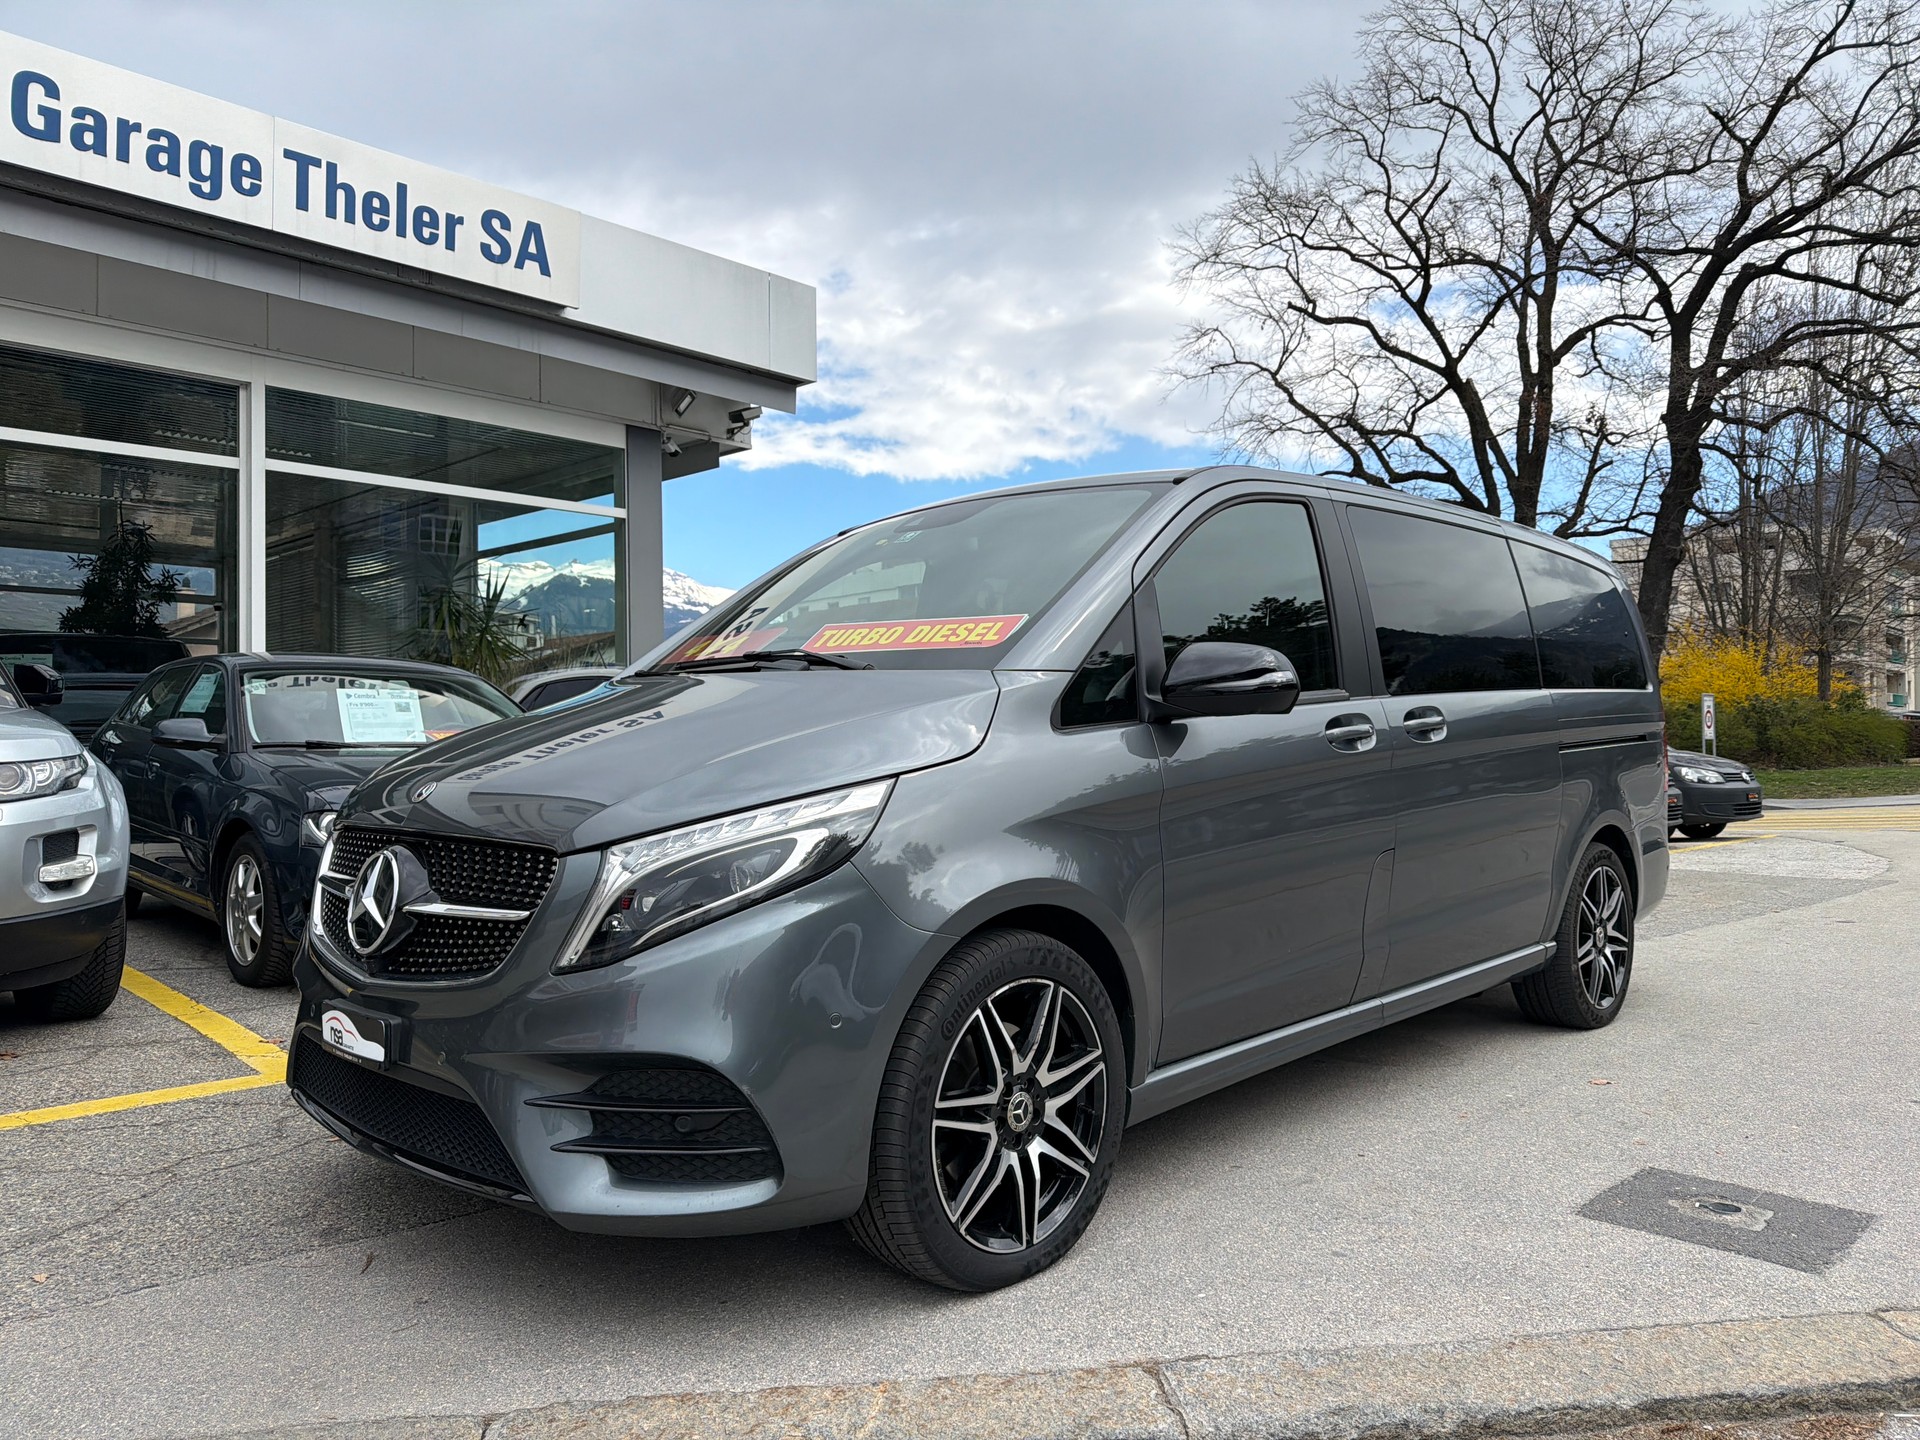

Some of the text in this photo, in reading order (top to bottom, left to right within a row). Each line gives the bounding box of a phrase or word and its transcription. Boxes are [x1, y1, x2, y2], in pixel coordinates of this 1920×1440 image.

[11, 71, 552, 278] Garage Theler SA
[814, 622, 1004, 648] TURBO DIESEL
[941, 961, 1008, 1042] Continental
